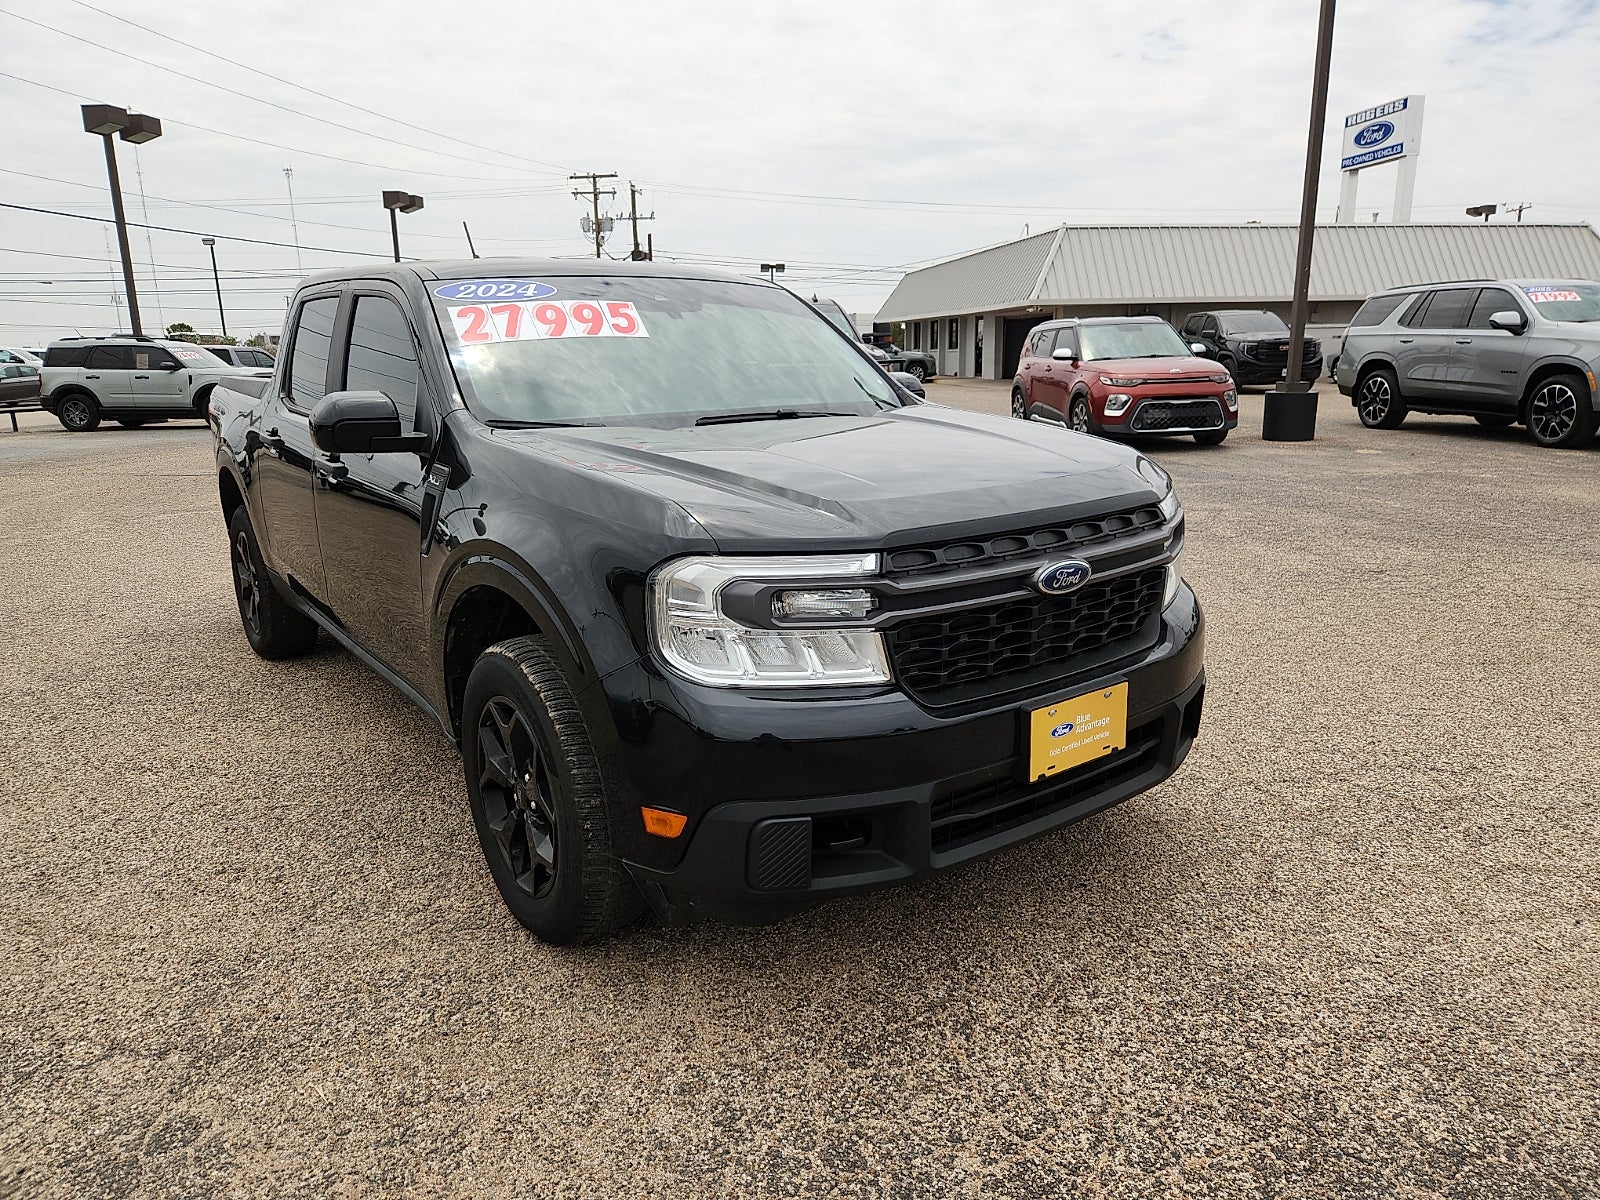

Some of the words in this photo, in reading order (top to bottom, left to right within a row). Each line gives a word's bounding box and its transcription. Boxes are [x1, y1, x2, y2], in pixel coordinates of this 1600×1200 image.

[1347, 99, 1404, 126] ROGERS
[1360, 125, 1385, 145] Ford
[1342, 152, 1374, 167] PRE-OWNED
[1374, 144, 1402, 159] VEHICLES
[455, 283, 538, 299] 2024
[1530, 291, 1578, 302] 71995
[456, 301, 640, 343] 27995
[1052, 568, 1082, 588] Ford
[1075, 716, 1111, 735] Advantage
[1076, 713, 1091, 724] Blue
[1054, 724, 1071, 737] Ford
[1049, 748, 1062, 757] Gold
[1061, 740, 1081, 752] Certified
[1081, 736, 1094, 746] Used
[1093, 731, 1110, 741] Vehicle
